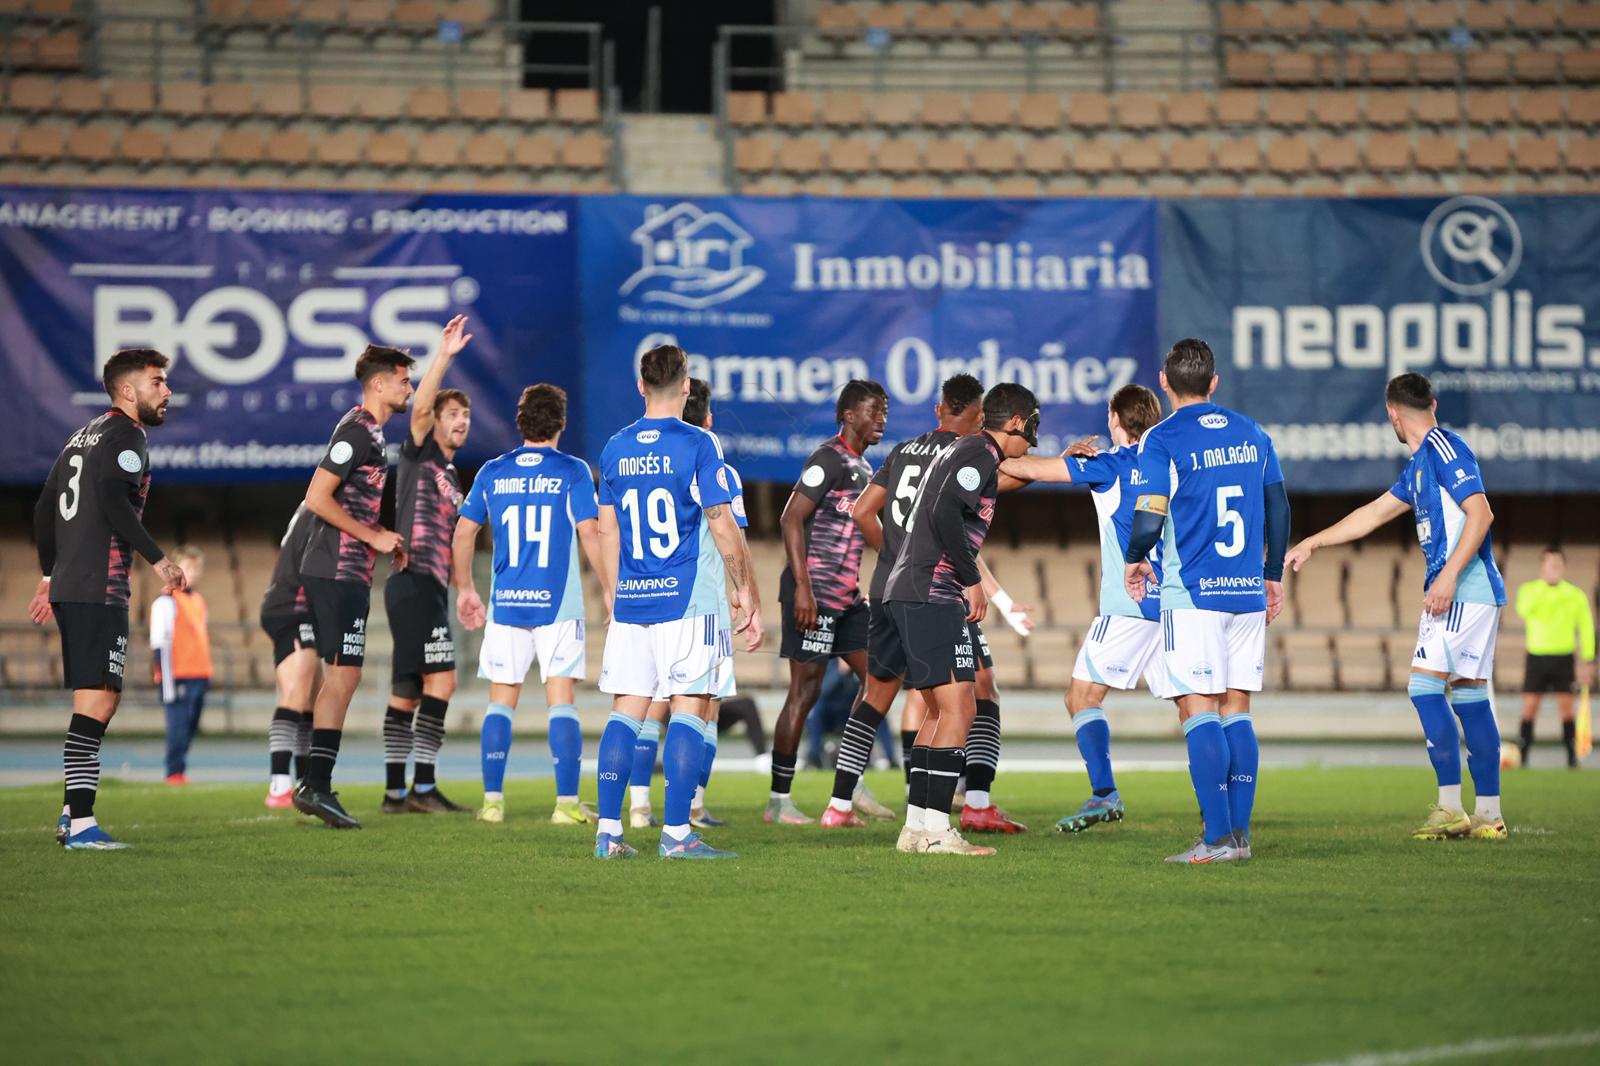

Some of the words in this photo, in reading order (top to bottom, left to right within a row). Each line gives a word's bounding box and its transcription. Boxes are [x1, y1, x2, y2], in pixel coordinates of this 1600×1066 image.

[208, 207, 348, 234] BOOKING
[372, 208, 568, 235] PRODUCTION
[236, 263, 317, 283] THE
[792, 242, 1152, 291] Inmobiliaria
[206, 388, 348, 412] MUSIC
[618, 451, 661, 477] MOISÉS
[663, 455, 674, 474] R.
[1190, 452, 1202, 471] J.
[1203, 440, 1259, 468] MALAGÓN
[59, 454, 84, 521] 3
[493, 477, 527, 495] JAIME
[528, 473, 562, 494] LÓPEZ
[621, 487, 680, 559] 19
[1214, 484, 1246, 558] 5
[501, 505, 552, 568] 14
[1230, 774, 1254, 783] XCD
